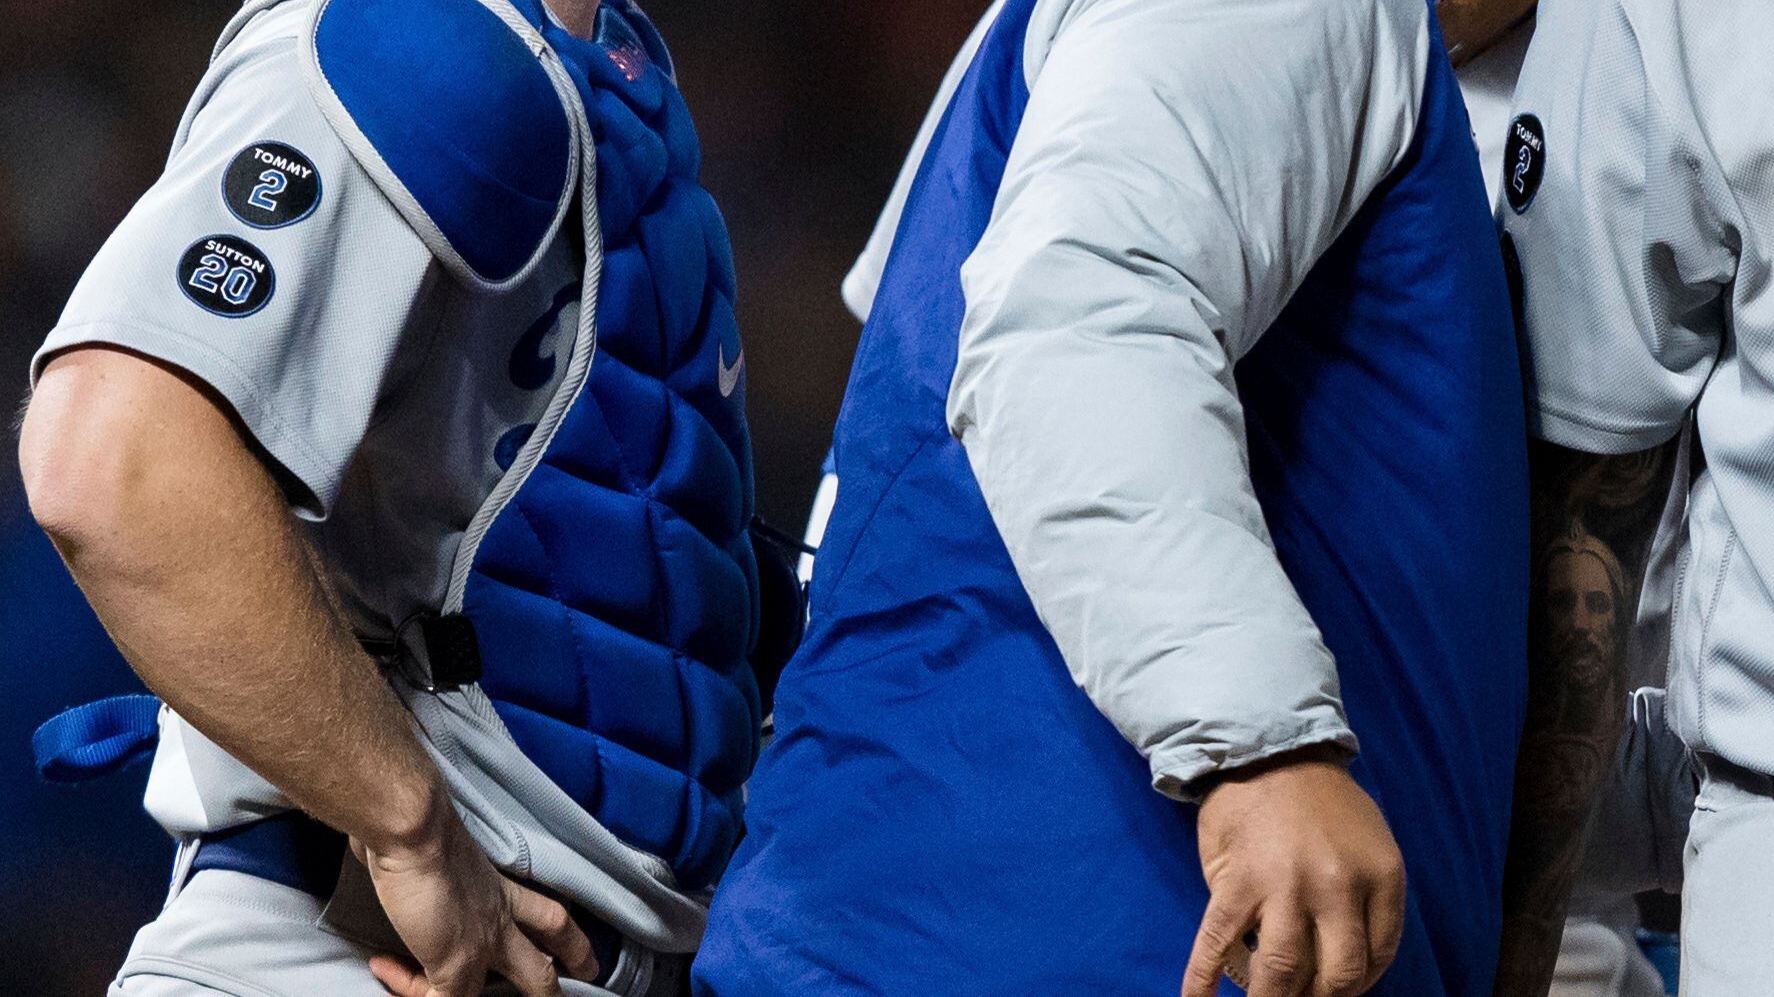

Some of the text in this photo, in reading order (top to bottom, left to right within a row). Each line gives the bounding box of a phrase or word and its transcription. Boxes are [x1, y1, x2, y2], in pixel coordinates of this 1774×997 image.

[253, 148, 313, 180] TOMMY
[1512, 145, 1532, 195] 2
[247, 168, 288, 212] 2
[204, 240, 266, 274] SUTTON
[188, 253, 257, 306] 20
